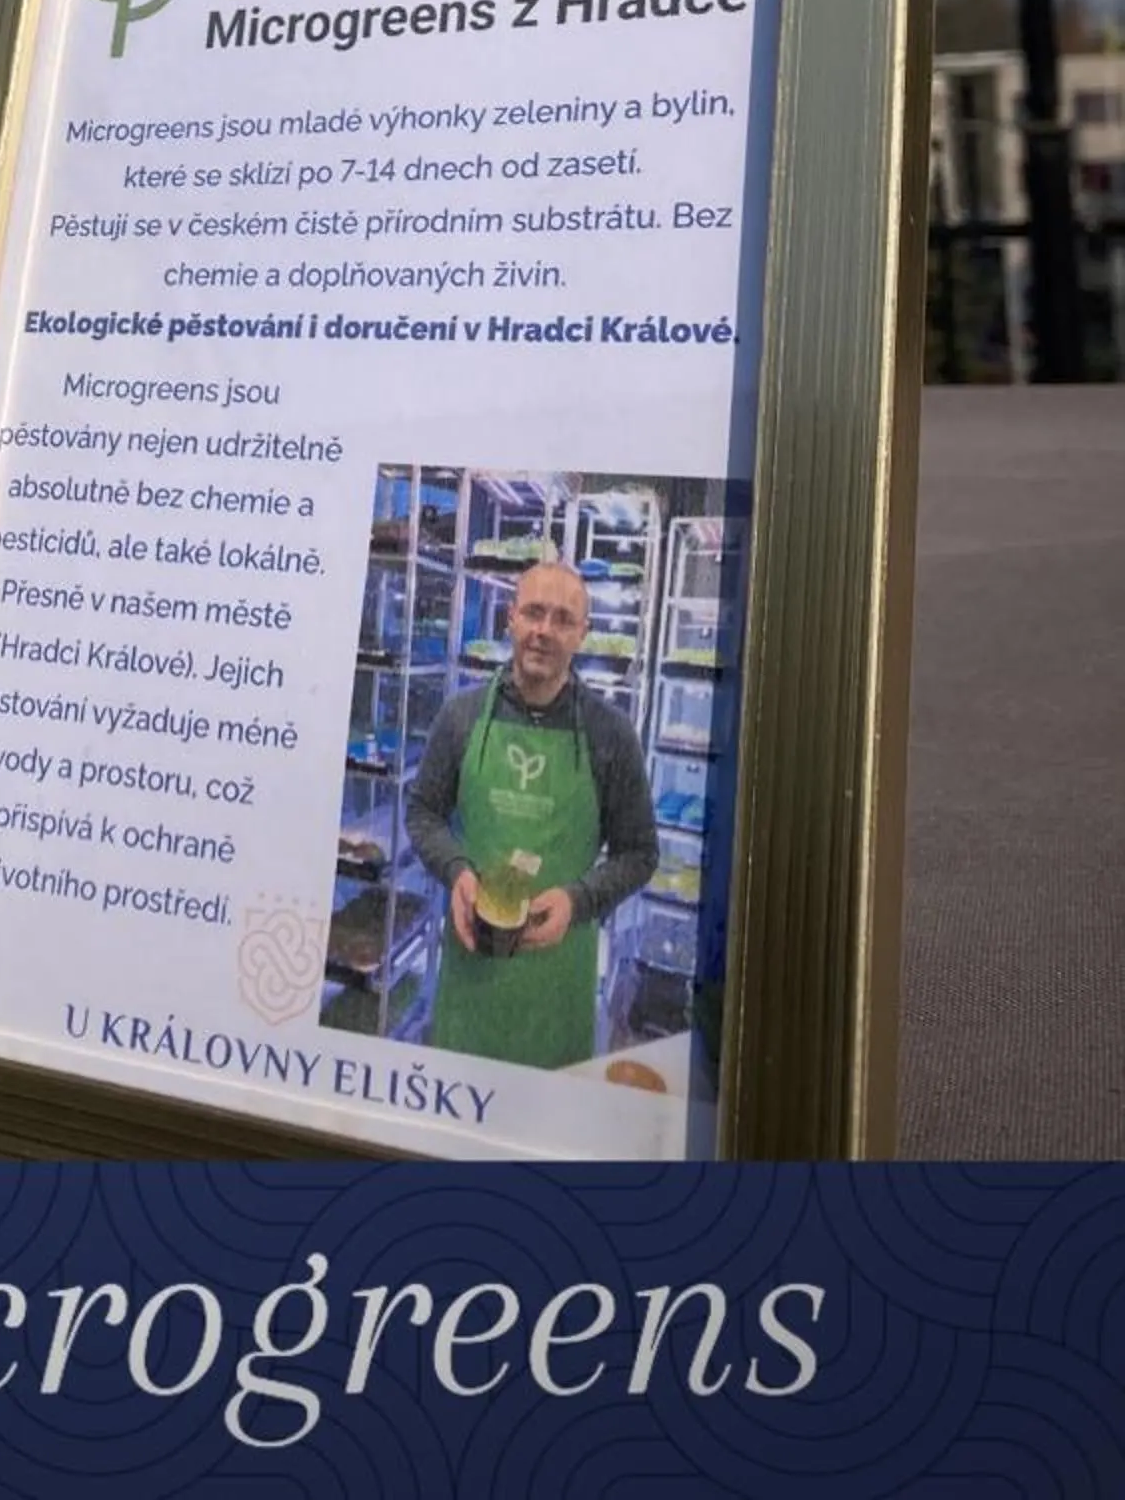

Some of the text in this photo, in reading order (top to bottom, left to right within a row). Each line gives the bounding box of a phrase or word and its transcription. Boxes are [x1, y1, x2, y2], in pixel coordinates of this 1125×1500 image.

[65, 118, 215, 147] Microgreens
[216, 112, 272, 143] jsou
[279, 106, 363, 135] mladé
[370, 102, 487, 138] výhonky
[492, 95, 618, 128] zeleniny
[624, 99, 643, 120] a
[123, 147, 642, 191] které se sklízí po 7-14 dnech od zasetí.
[50, 201, 733, 242] Pěstují se v českém čistě přírodním substrátu. Bez
[164, 260, 567, 294] chemie a doplňovaných živin.
[24, 310, 740, 345] Ekologické pěstování i doručení v Hradci Králové.
[62, 371, 281, 408] Microgreens jsou
[127, 428, 199, 459] nejen
[205, 430, 345, 463] udržitelně
[8, 473, 314, 518] absolutně bez chemie a
[108, 533, 148, 561] ale
[154, 535, 212, 567] také
[218, 538, 327, 577] lokálně.
[0, 577, 293, 630] Přesně v našem městě
[86, 641, 199, 681] Králové).
[204, 654, 285, 691] Jejich
[92, 701, 211, 743] vyžaduje
[216, 717, 299, 750] méně
[58, 756, 73, 779] a
[79, 757, 198, 800] prostoru,
[205, 775, 256, 806] což
[99, 815, 118, 845] k
[122, 822, 238, 865] ochraně
[102, 881, 233, 926] prostředí.
[66, 1003, 498, 1125] U KRÁLOVNY ELIŠKY
